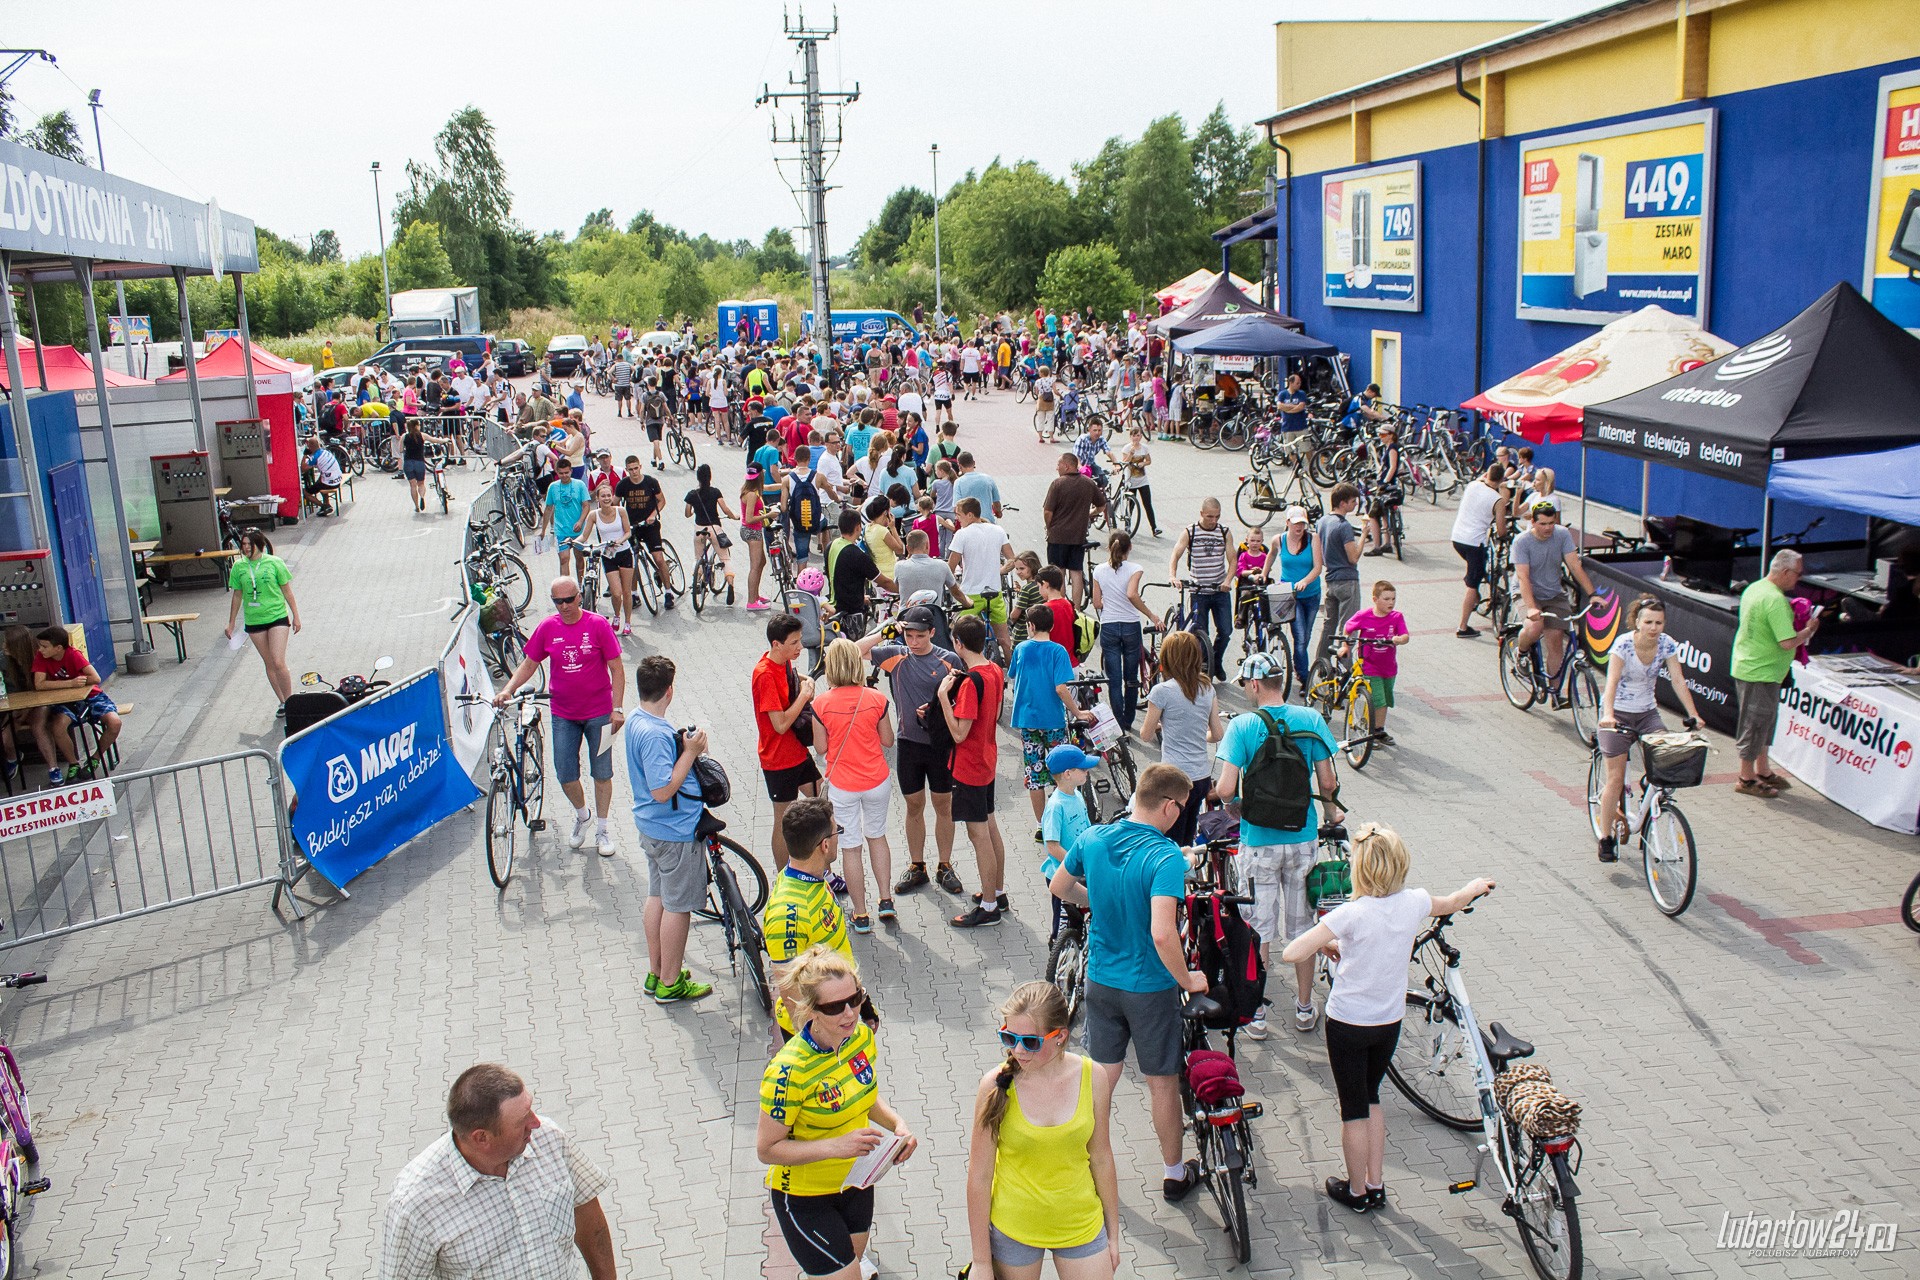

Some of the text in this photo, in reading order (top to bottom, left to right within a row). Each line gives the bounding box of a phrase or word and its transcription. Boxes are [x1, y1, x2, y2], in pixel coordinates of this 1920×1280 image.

[1530, 162, 1550, 184] HIT
[143, 201, 173, 252] 24h
[1655, 223, 1693, 238] ZESTAW
[1662, 246, 1692, 260] MARO
[1619, 286, 1693, 302] www.mrowka.com.pl
[834, 321, 857, 331] MAPEI
[1661, 386, 1742, 408] interduo
[1598, 422, 1742, 467] internet telewizja telefon
[1779, 679, 1899, 757] ubartowski
[361, 722, 416, 784] MAPEI
[1786, 716, 1877, 774] jest co czytać!
[307, 734, 441, 857] Budujesz raz, a dobrze!
[0, 811, 77, 838] UCZESTNIKÓW
[783, 904, 797, 950] DETAX
[770, 1064, 790, 1119] DETAX
